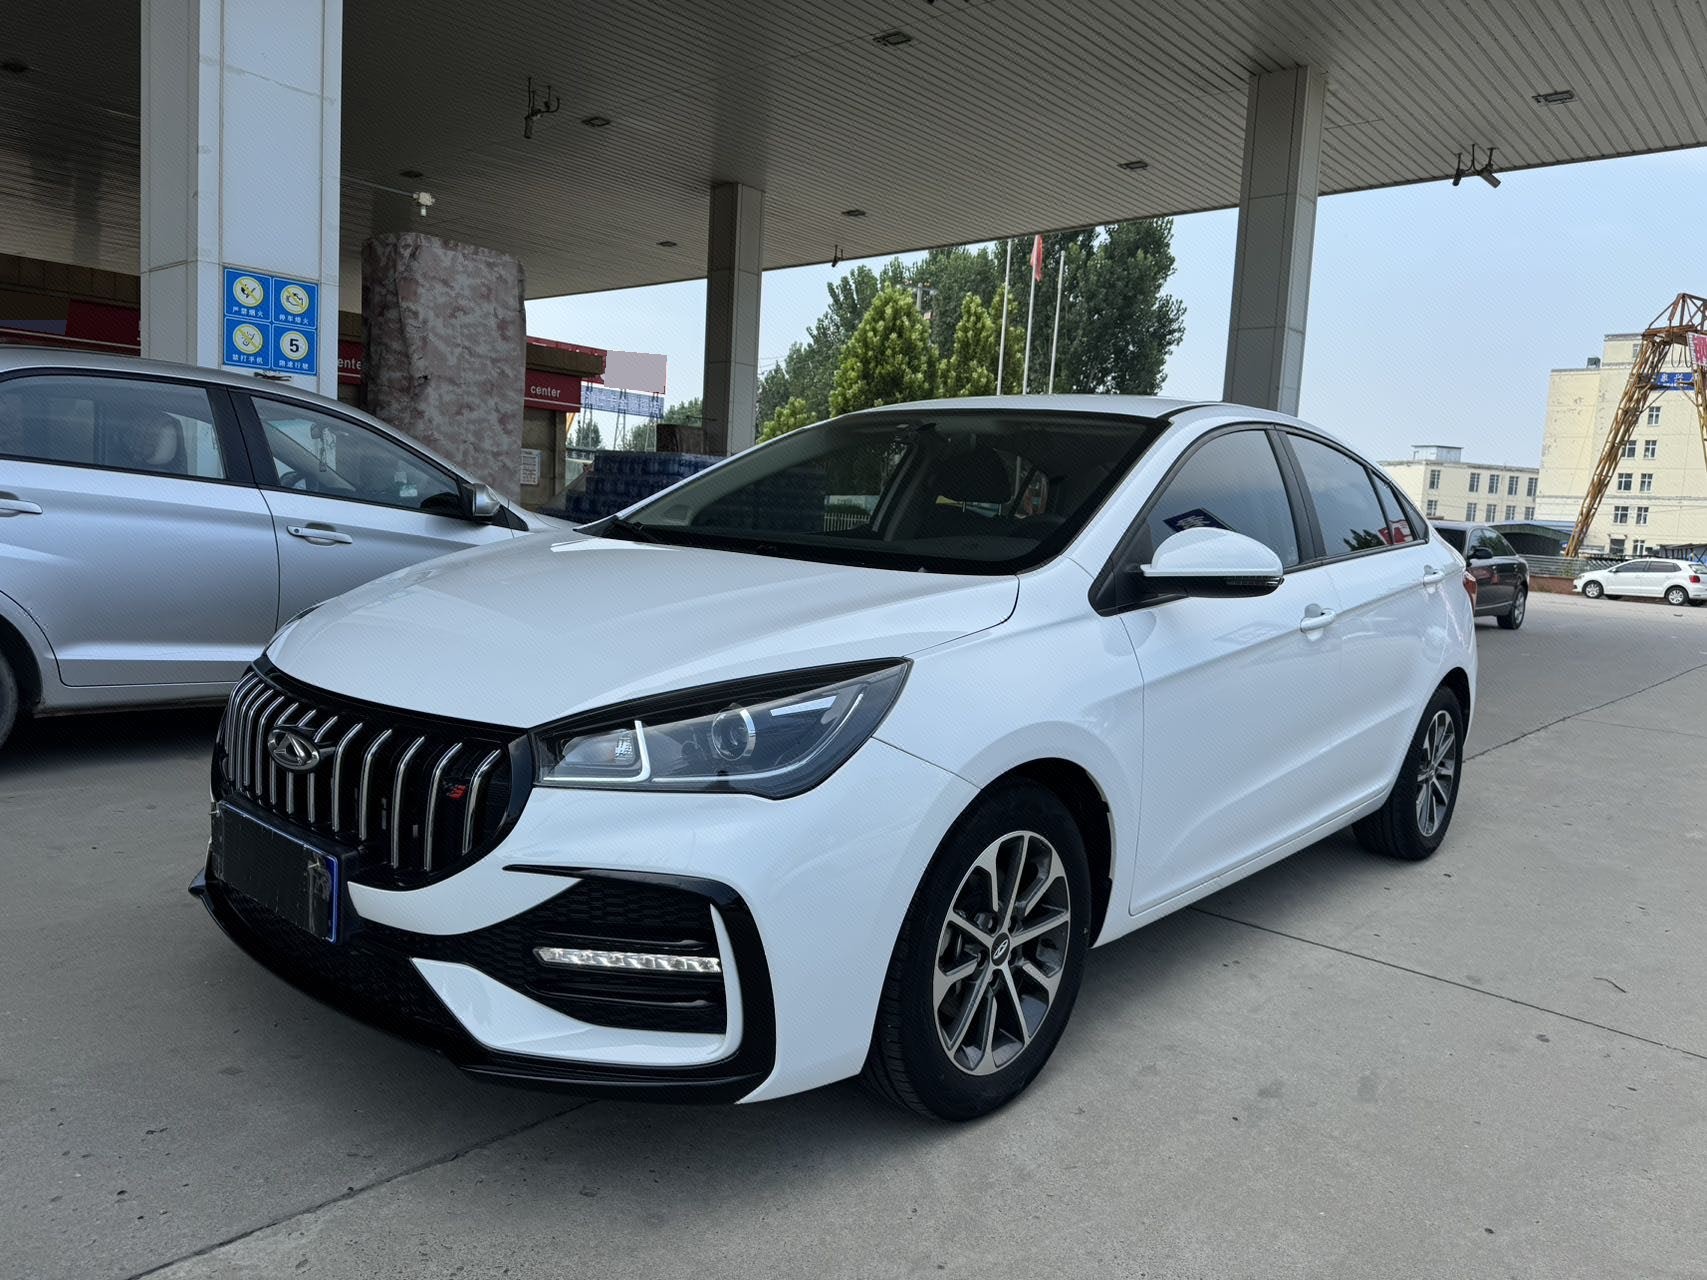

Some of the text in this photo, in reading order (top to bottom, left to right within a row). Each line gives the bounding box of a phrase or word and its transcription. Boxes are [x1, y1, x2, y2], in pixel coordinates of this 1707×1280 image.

[232, 306, 264, 318] 严禁烟火
[279, 314, 309, 325] 停车熄火
[289, 338, 300, 353] 5
[232, 354, 264, 364] 禁打手机
[530, 385, 561, 398] center
